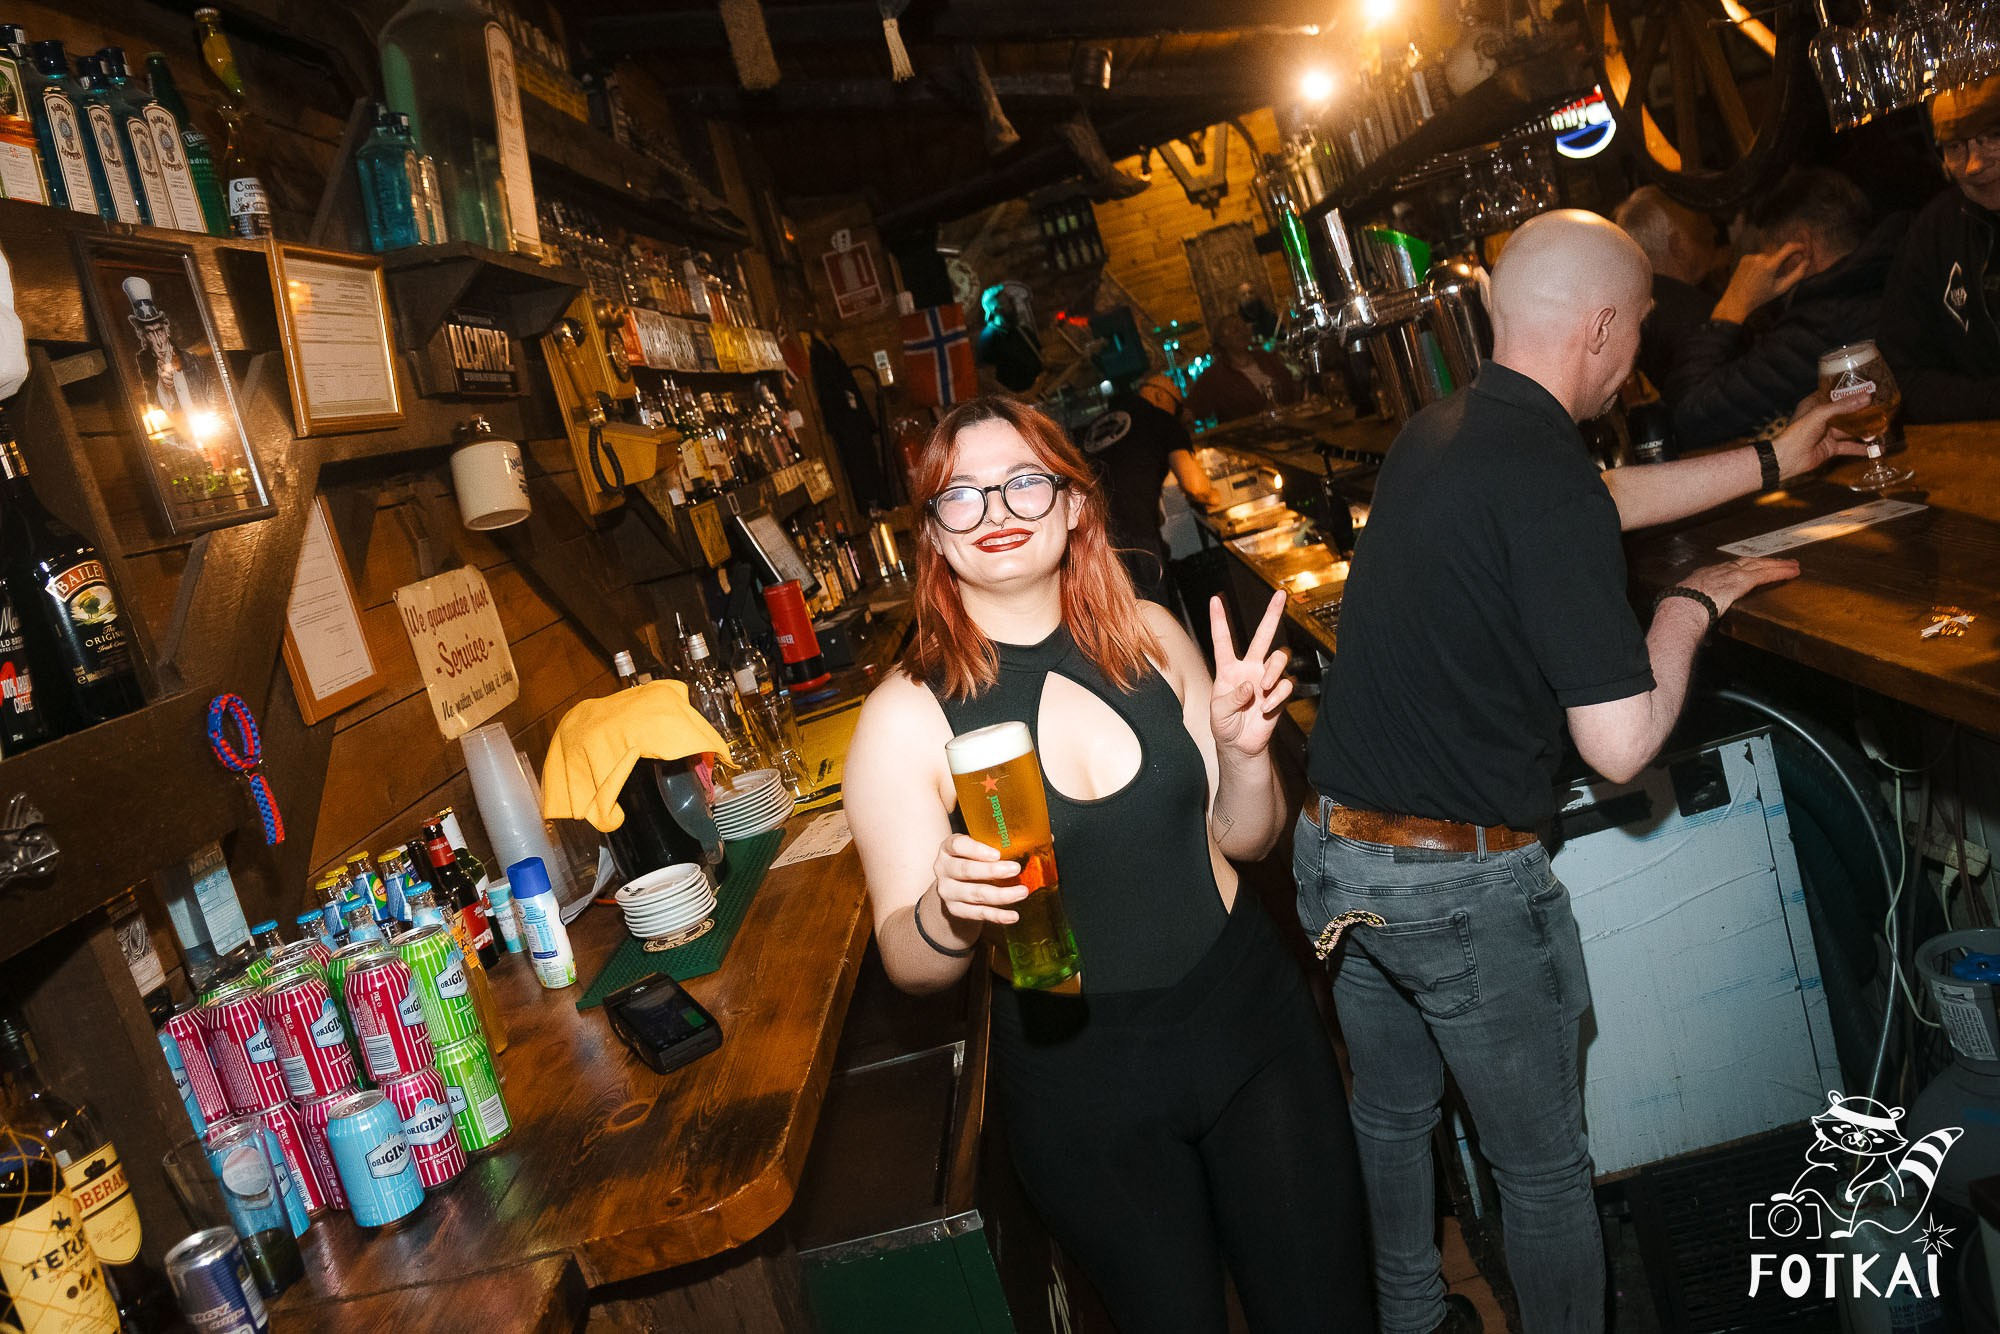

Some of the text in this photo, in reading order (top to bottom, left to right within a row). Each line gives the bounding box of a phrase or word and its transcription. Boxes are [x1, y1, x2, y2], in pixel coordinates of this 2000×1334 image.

[404, 604, 427, 637] We
[427, 592, 470, 636] guarantee
[437, 633, 489, 678] Service
[990, 795, 1011, 848] Heineken
[407, 1111, 450, 1135] ORIGINAL
